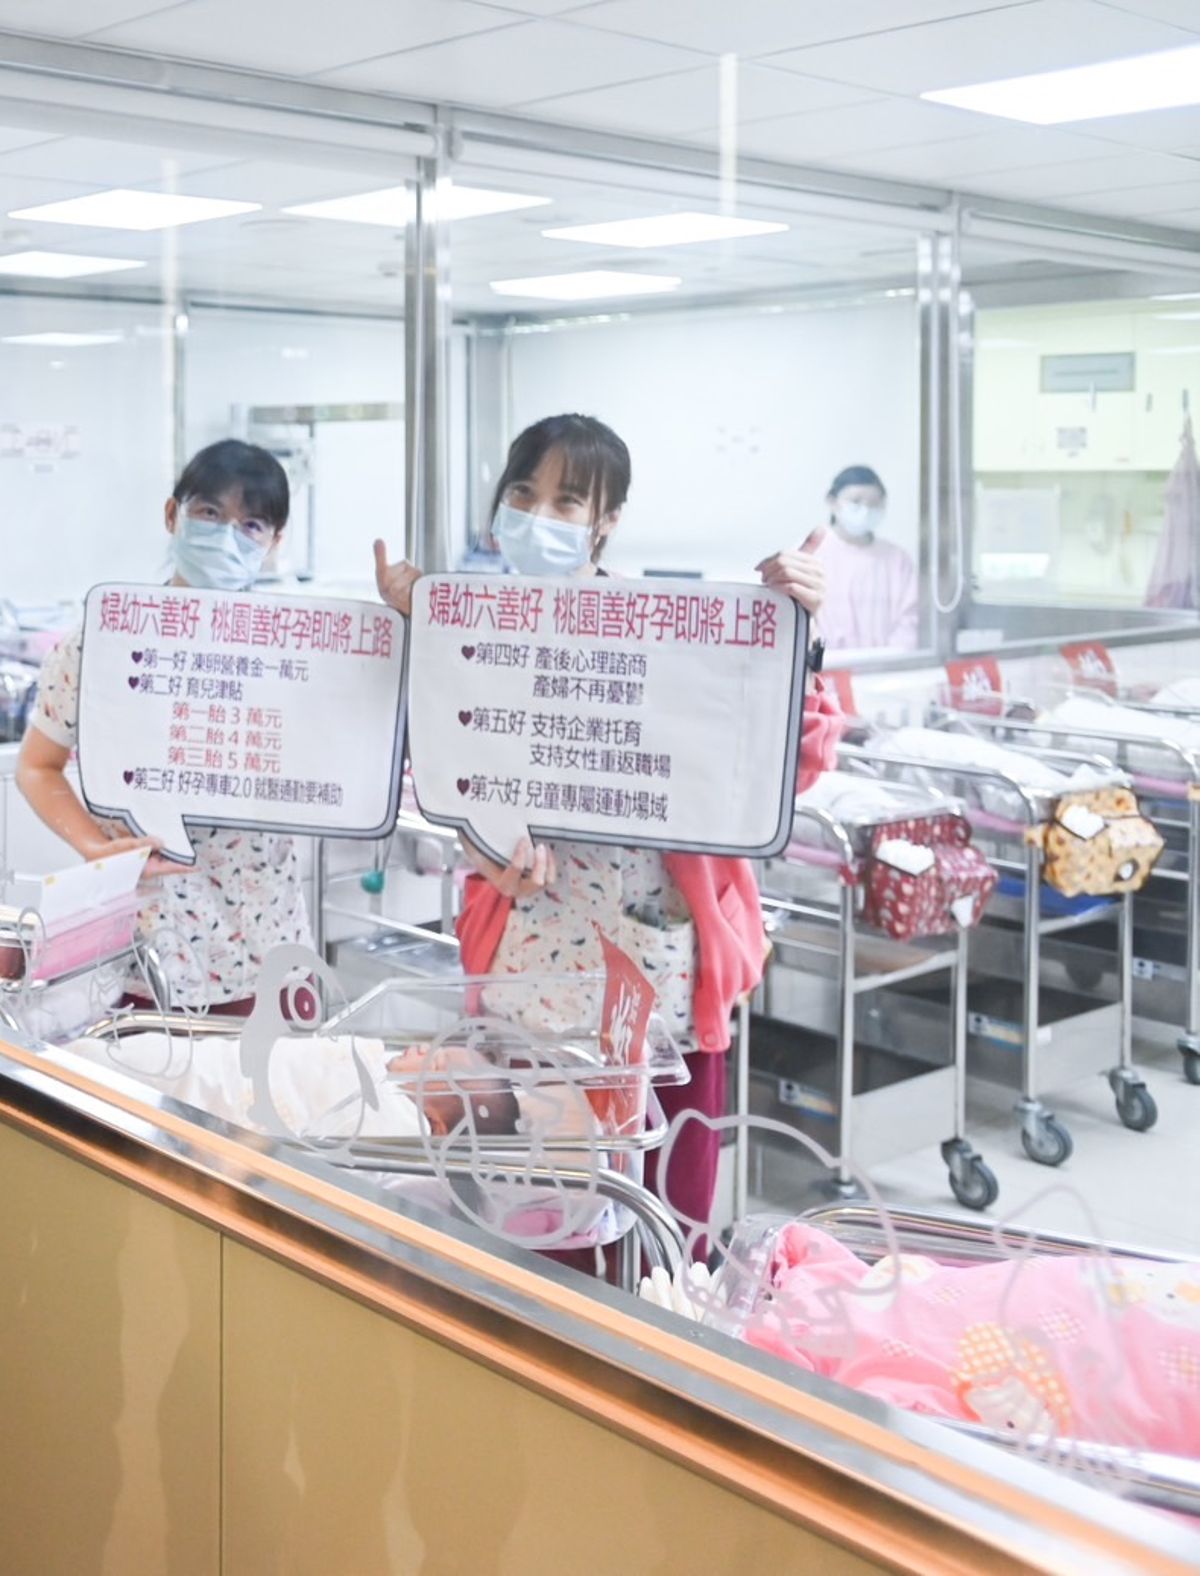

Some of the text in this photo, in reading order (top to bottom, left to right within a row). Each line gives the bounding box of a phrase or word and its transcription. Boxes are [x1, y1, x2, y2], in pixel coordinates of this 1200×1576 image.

[100, 592, 393, 658] 婦幼六善好 桃園善好孕即將上路
[428, 582, 777, 648] 婦幼六善好 桃園善好孕即將上路
[143, 648, 187, 672] 第一好
[476, 642, 647, 677] 第四好 產後心理諮商
[139, 673, 182, 696] 第二好
[473, 707, 642, 748] 第五好 支持企業托育
[133, 767, 175, 792] 第三好
[469, 774, 668, 822] 第六好 兒童專屬運動場域
